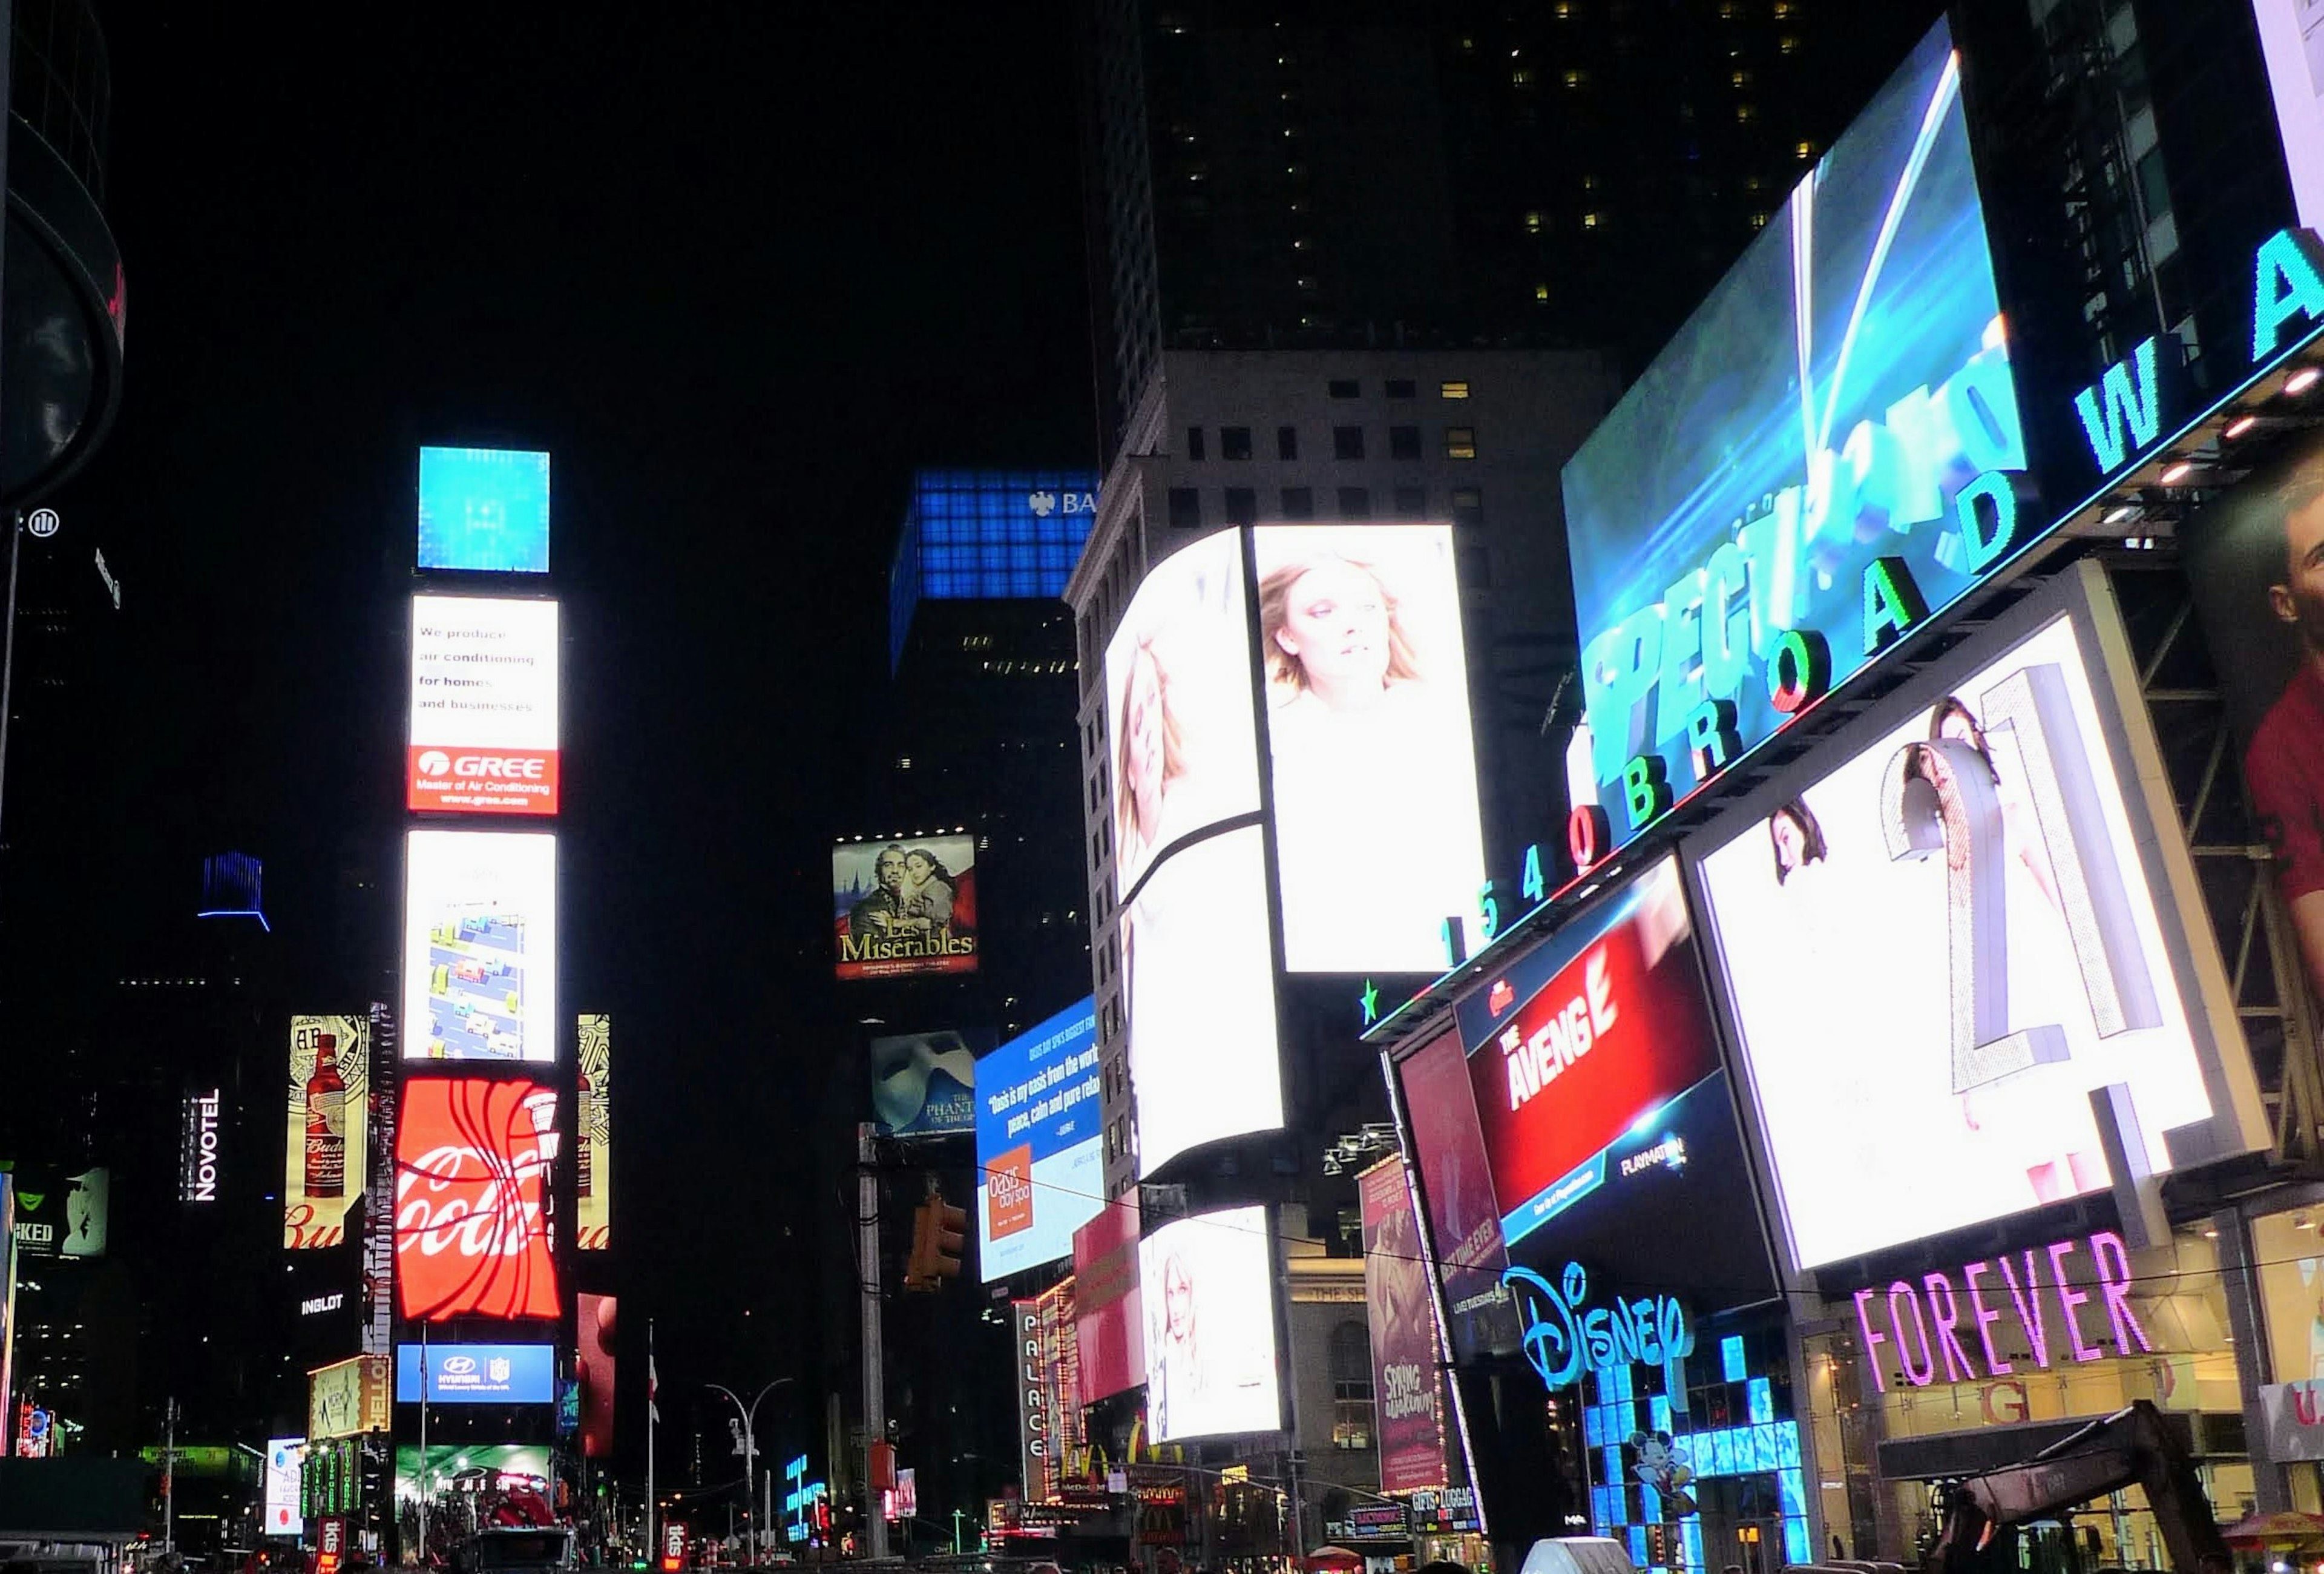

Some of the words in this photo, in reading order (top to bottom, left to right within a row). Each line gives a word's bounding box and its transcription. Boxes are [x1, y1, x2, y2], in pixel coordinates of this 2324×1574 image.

[420, 627, 441, 637] We
[447, 629, 506, 640] produce
[419, 653, 439, 661] air
[444, 652, 534, 665] conditioning
[419, 676, 440, 686] for
[444, 677, 493, 688] homes
[418, 699, 445, 709] and
[451, 700, 533, 712] businesses
[454, 756, 545, 779] GREE
[416, 779, 452, 791] Master
[454, 780, 466, 791] of
[468, 780, 483, 791] Air
[484, 781, 550, 795] Conditioning
[440, 794, 528, 806] www.gree.com
[1440, 805, 1604, 969] 1540
[1880, 662, 2164, 1095] 21
[839, 926, 973, 962] Misérables
[887, 917, 919, 938] Les
[1500, 1022, 1521, 1056] THE
[1505, 941, 1620, 1113] AVENGE
[1009, 1087, 1017, 1106] is
[1017, 1083, 1028, 1103] my
[1046, 1065, 1065, 1086] from
[1065, 1055, 1078, 1077] the
[1031, 1100, 1049, 1124] calm
[1049, 1090, 1063, 1115] and
[1063, 1085, 1081, 1113] pure
[195, 1090, 220, 1202] NOVOTEL
[989, 1165, 1019, 1199] Oasis
[301, 1293, 343, 1315] INGLOT
[1853, 1231, 2152, 1393] FOREVER
[370, 1360, 388, 1428] HELLO
[1025, 1316, 1045, 1457] PALACE
[1412, 1490, 1436, 1512] GIFTS
[325, 1521, 340, 1553] tkts
[666, 1524, 685, 1556] tkts
